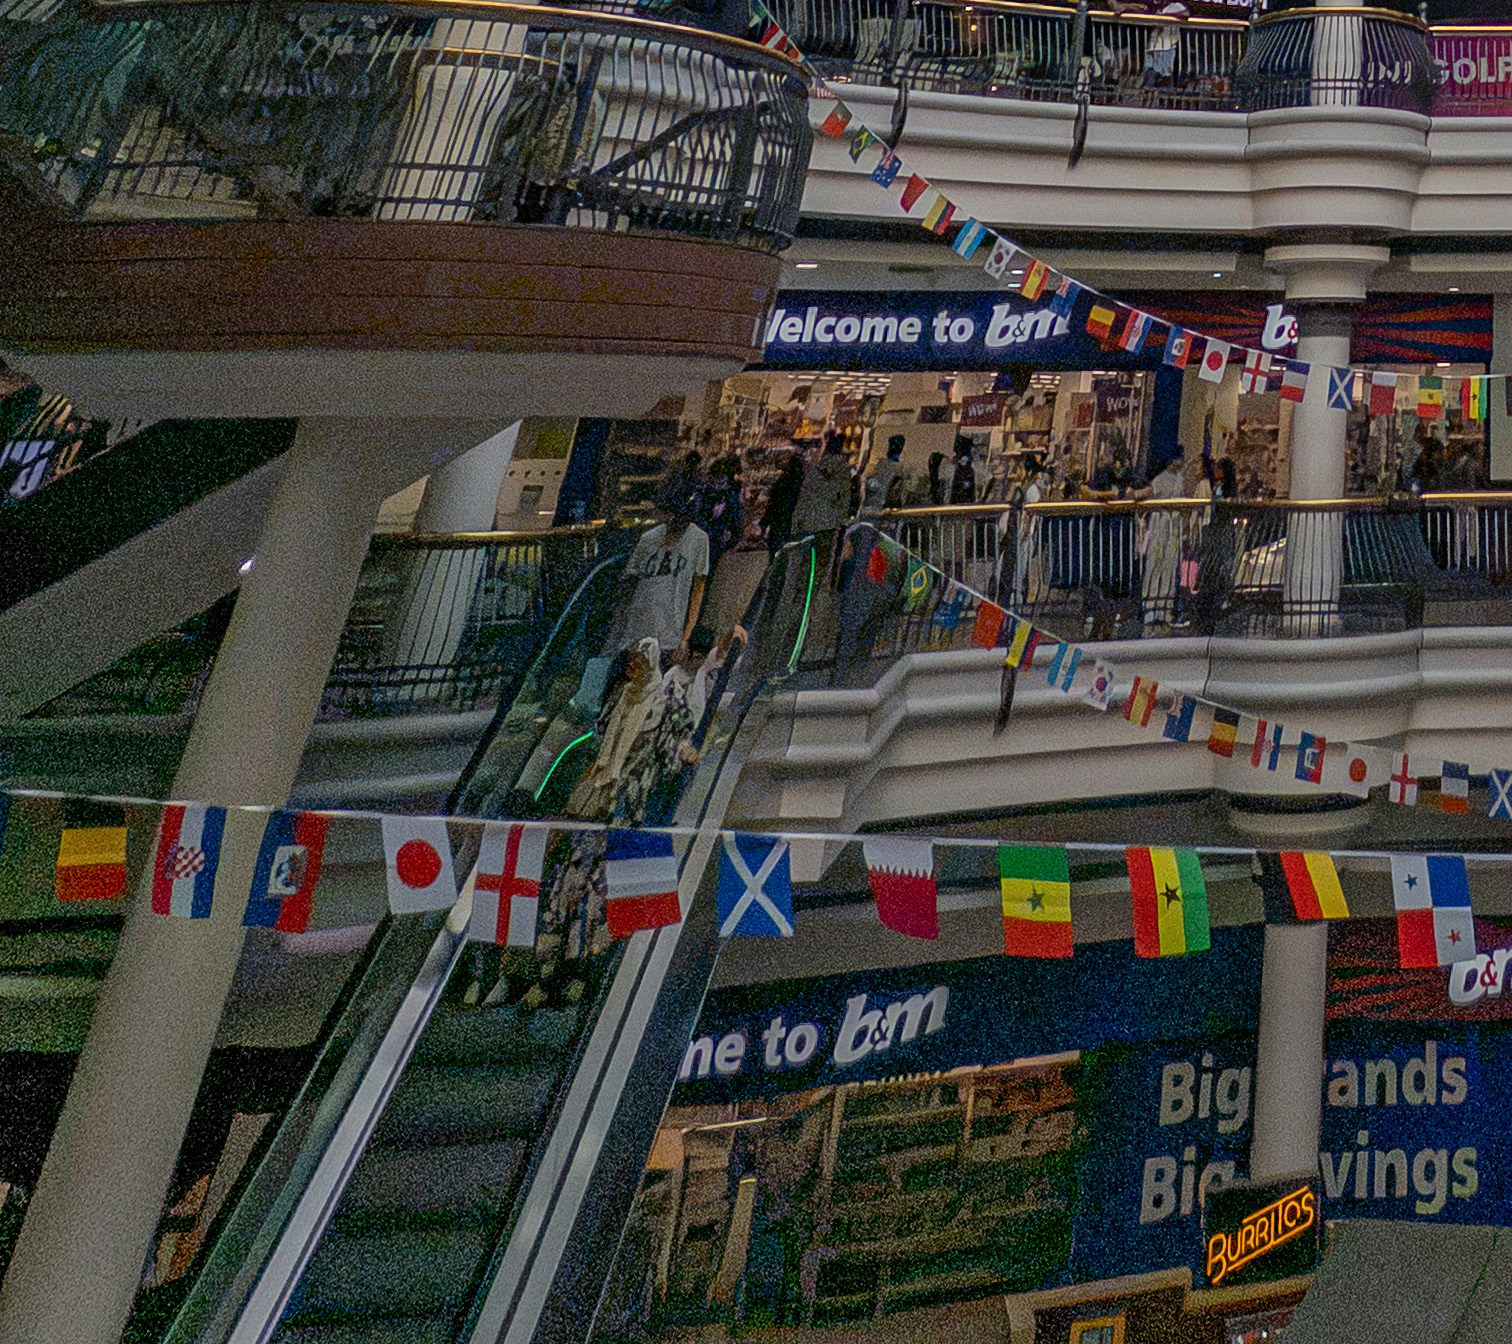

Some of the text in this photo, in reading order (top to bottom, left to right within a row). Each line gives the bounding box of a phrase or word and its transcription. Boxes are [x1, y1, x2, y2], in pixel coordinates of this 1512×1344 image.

[932, 310, 975, 344] to
[762, 1015, 818, 1068] to
[833, 985, 950, 1065] b&m
[1159, 1040, 1469, 1134] Big ands
[1320, 1129, 1479, 1214] vings
[1206, 1187, 1315, 1285] BURRITOS
